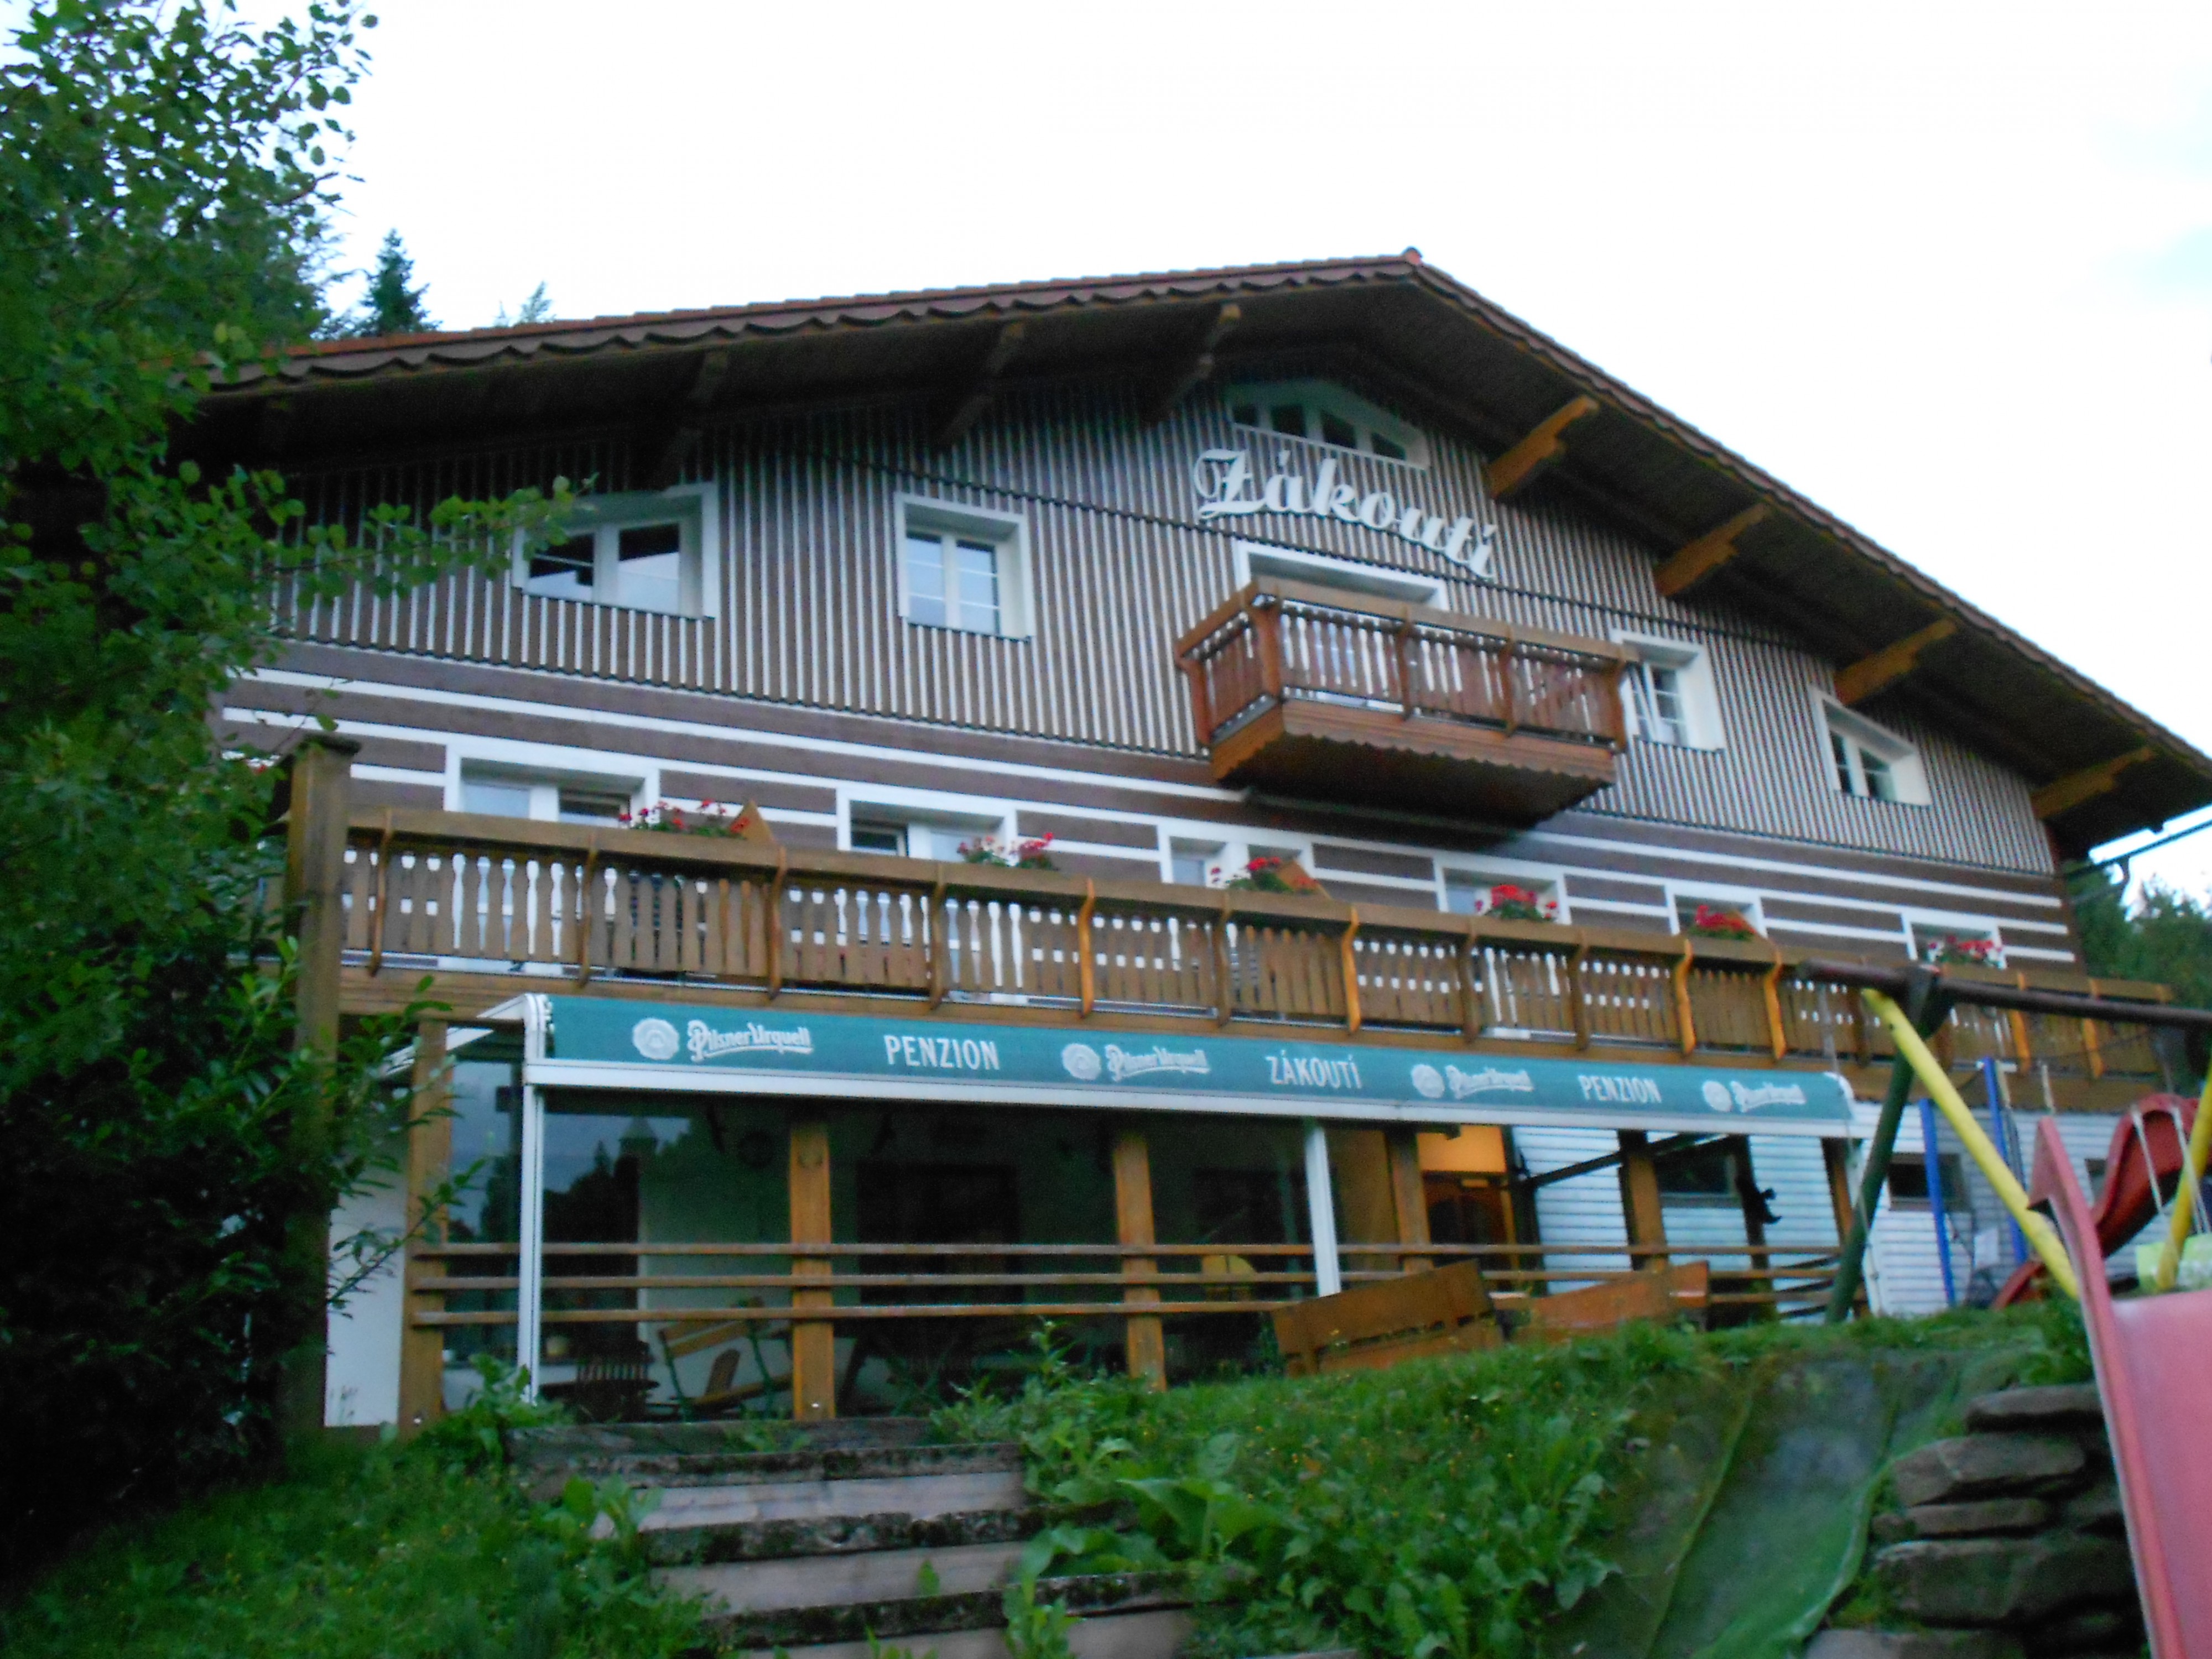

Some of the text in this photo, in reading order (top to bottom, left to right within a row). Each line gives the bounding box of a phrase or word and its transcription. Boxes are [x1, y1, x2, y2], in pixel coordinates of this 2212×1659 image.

[688, 1020, 812, 1062] Pilsner Urquell
[883, 1035, 1000, 1070] PENZION
[1266, 1050, 1362, 1089] ZÁKOUTÍ
[1578, 1075, 1662, 1103] PENZION
